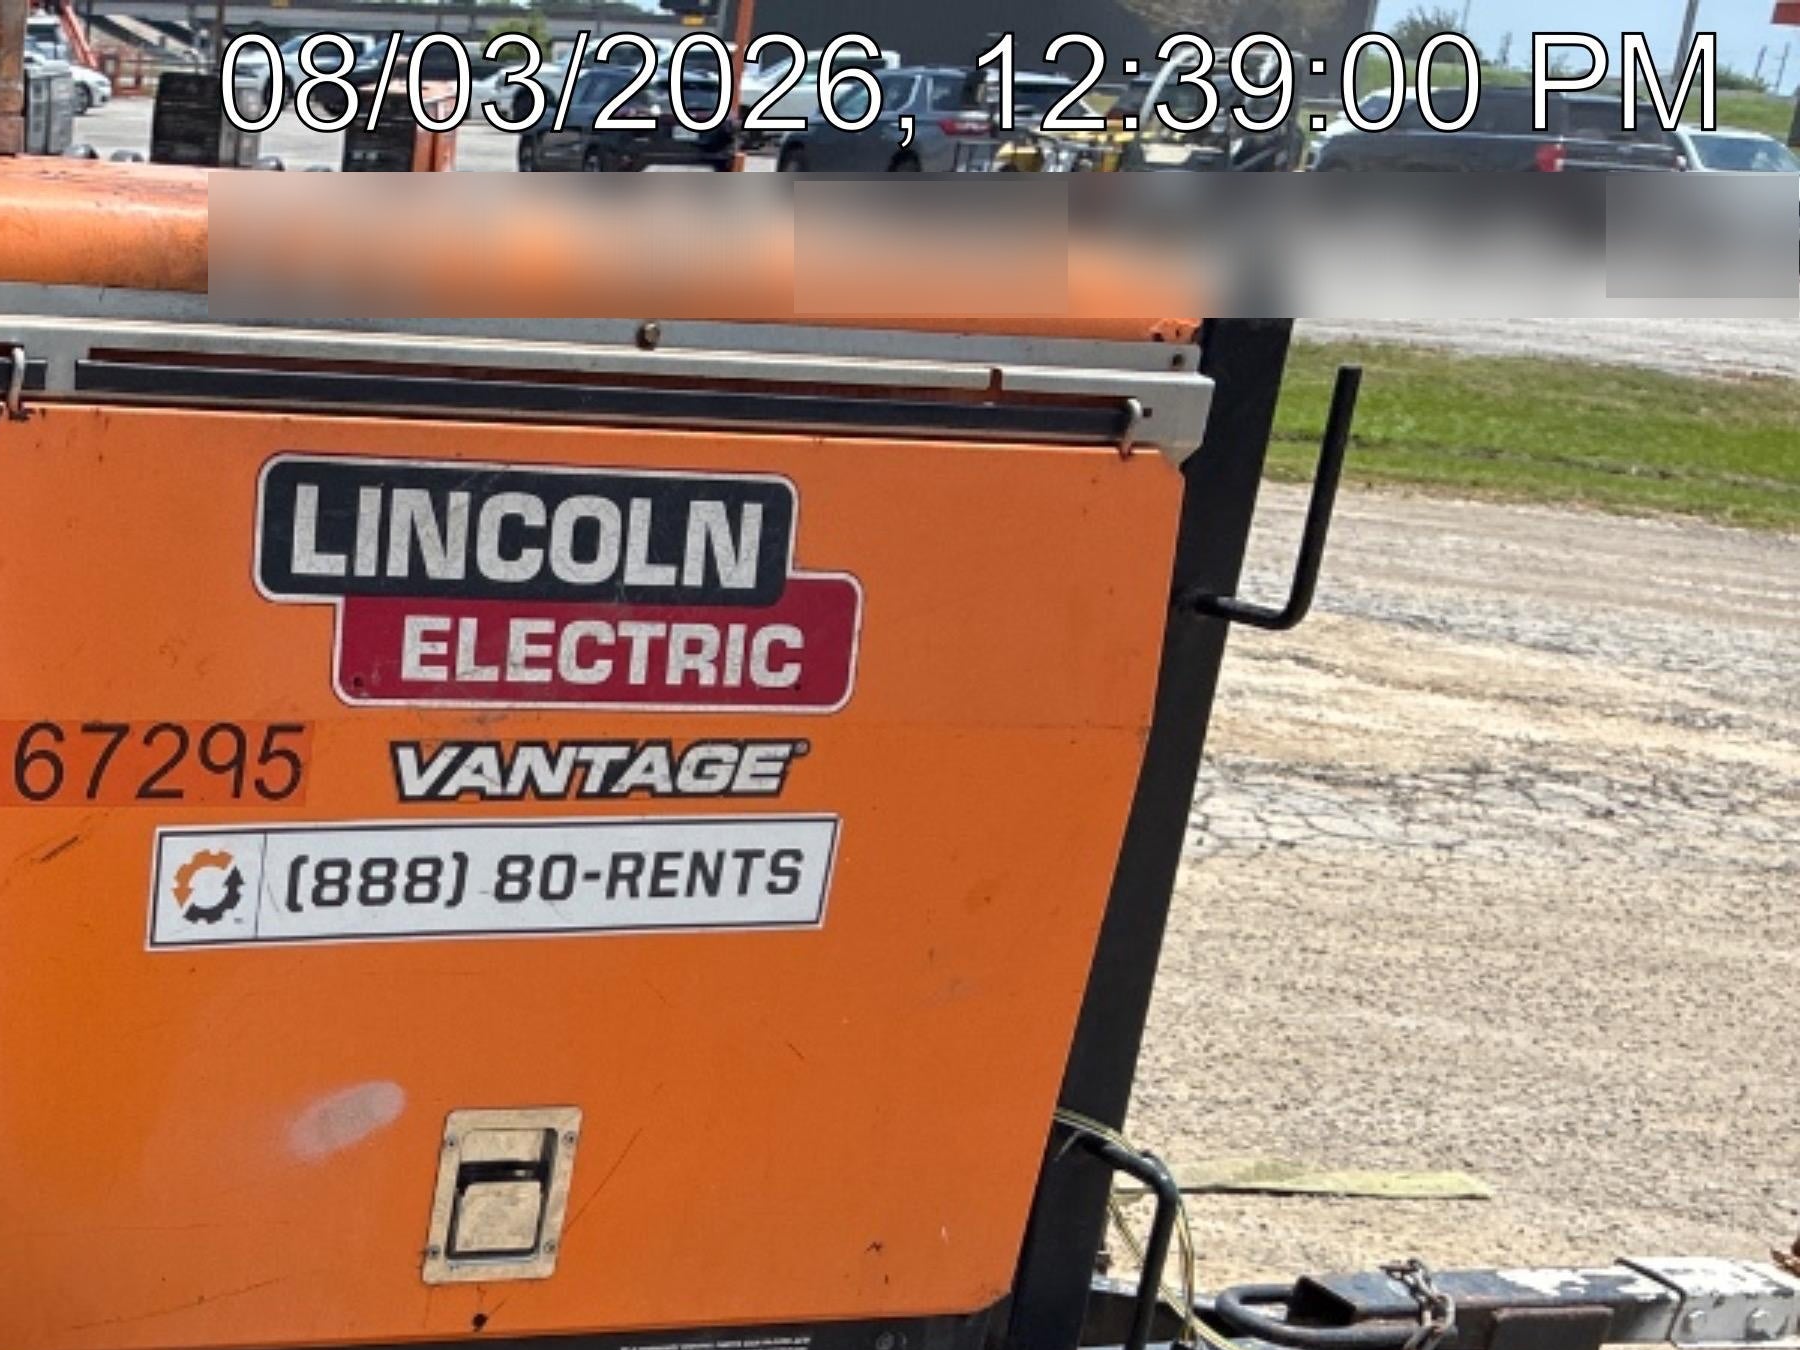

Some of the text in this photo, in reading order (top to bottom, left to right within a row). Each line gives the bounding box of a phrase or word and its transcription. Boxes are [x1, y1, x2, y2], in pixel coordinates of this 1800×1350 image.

[290, 483, 764, 590] LINCOLN
[401, 615, 805, 688] ELECTRIC
[392, 741, 796, 800] VANTAGE
[285, 848, 804, 912] (888) 80-RENTS
